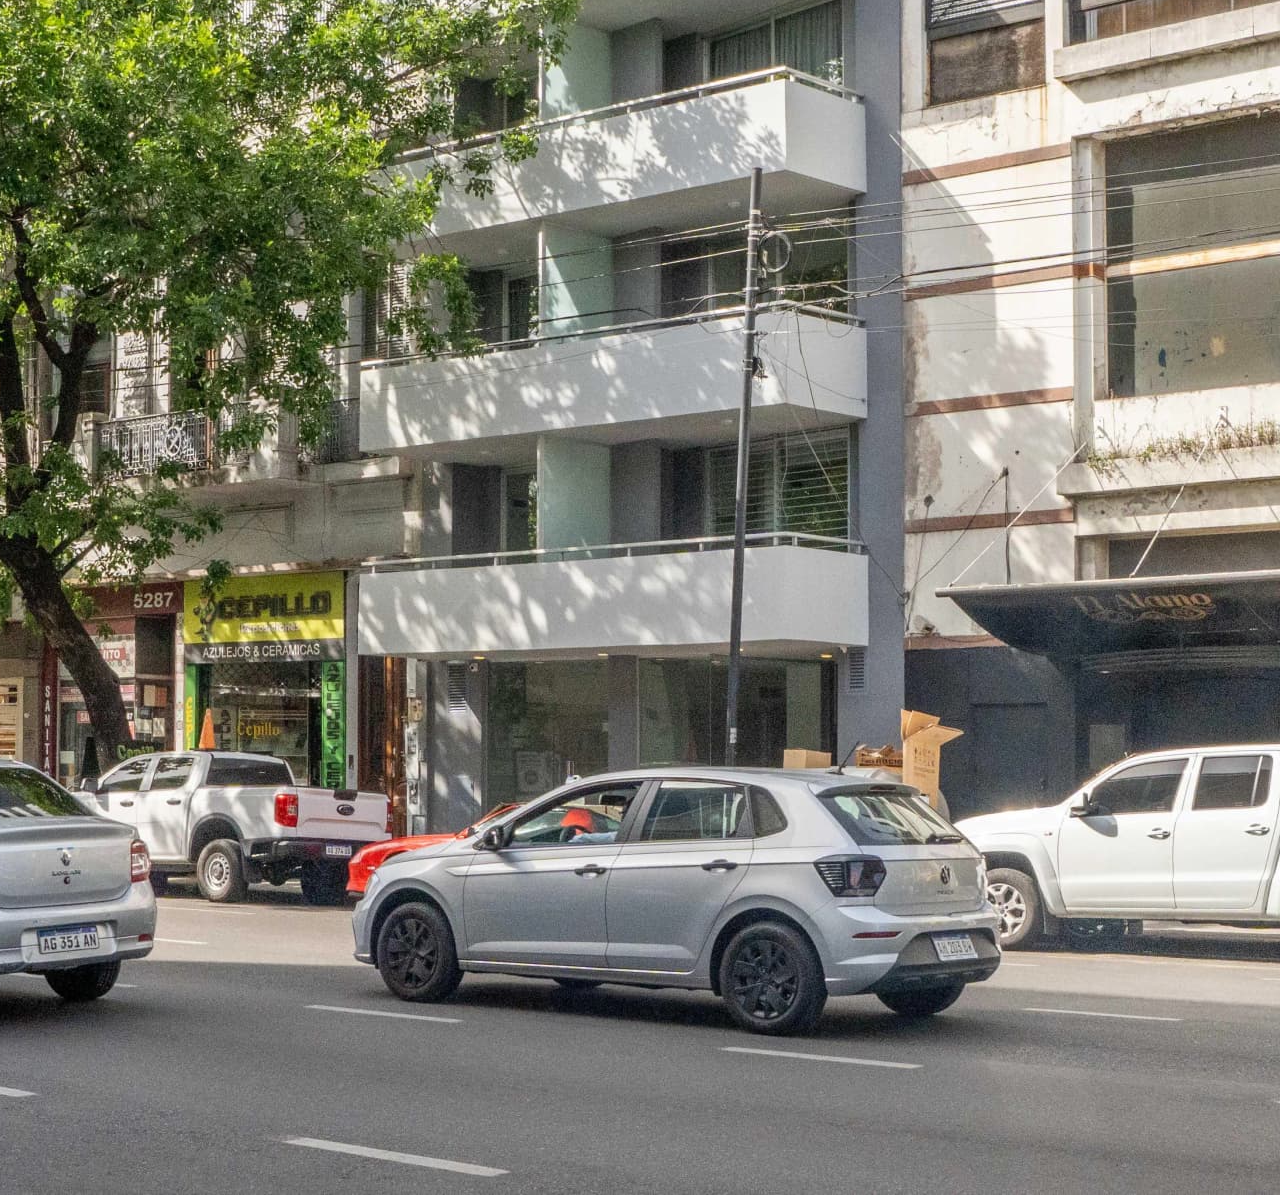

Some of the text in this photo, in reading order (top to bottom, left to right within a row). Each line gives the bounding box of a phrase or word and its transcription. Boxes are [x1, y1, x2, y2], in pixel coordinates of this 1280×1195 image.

[133, 592, 173, 609] 5287
[219, 590, 331, 620] CEPILLO
[203, 642, 321, 659] AZULEJOS & CERAMICAS
[43, 934, 98, 951] AG 351 AN
